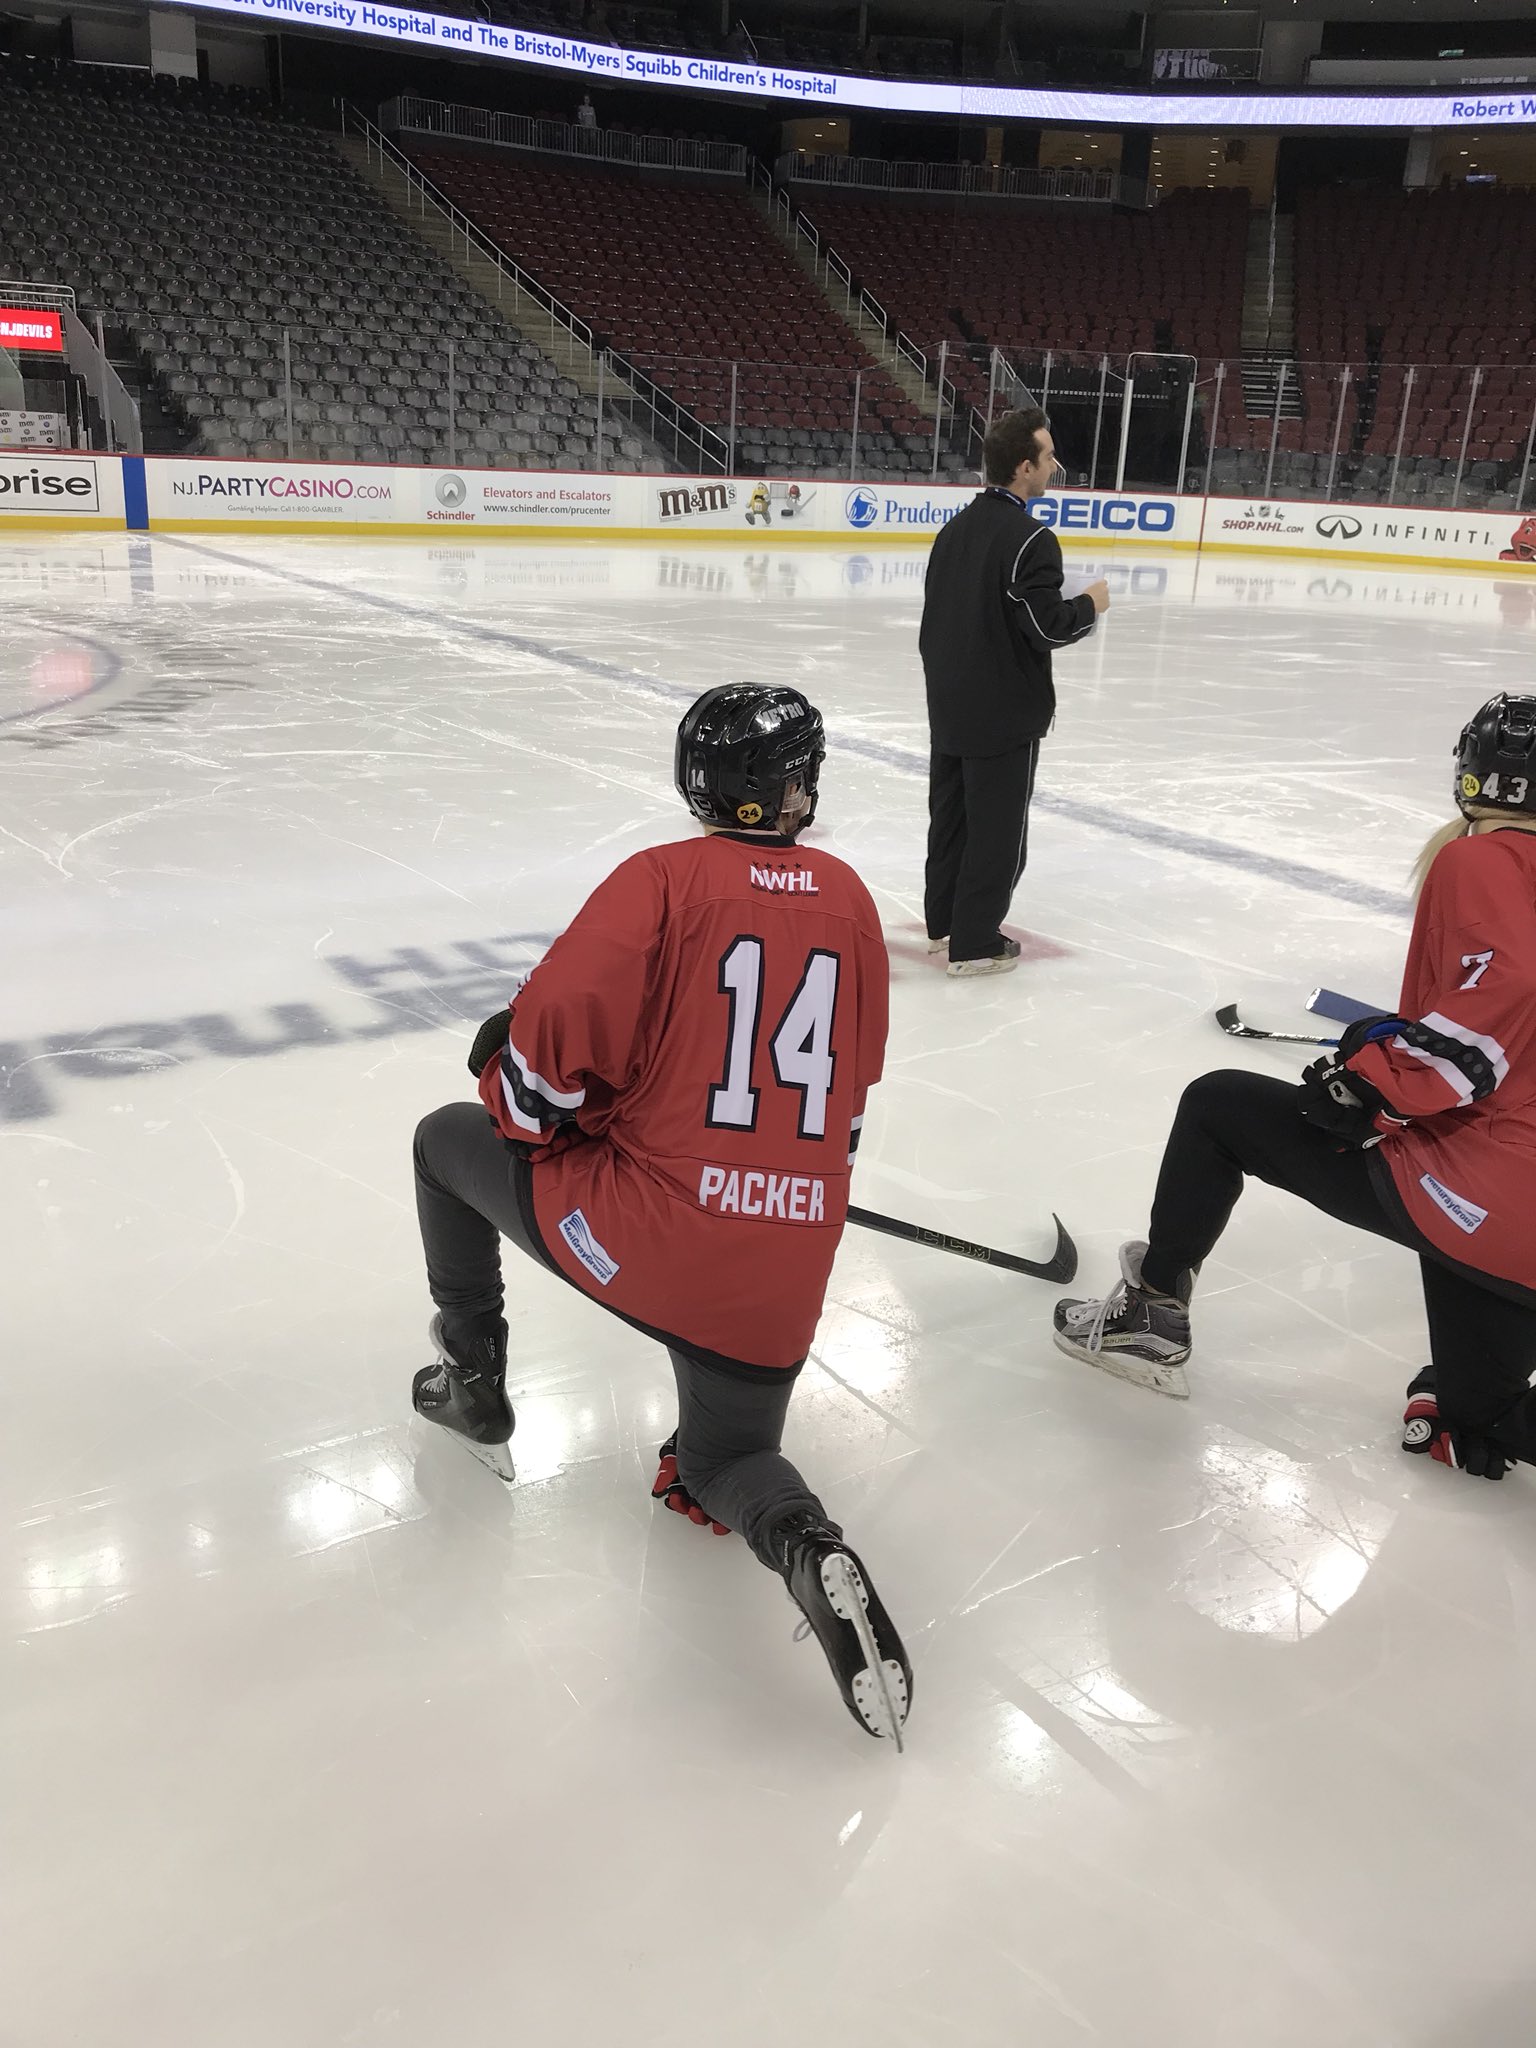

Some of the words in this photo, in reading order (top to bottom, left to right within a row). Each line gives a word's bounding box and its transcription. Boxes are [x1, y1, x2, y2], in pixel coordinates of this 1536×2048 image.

[363, 5, 436, 35] Hospital
[442, 22, 472, 42] and
[478, 28, 509, 48] The
[515, 34, 620, 69] Bristol-Myers
[626, 55, 681, 77] Squibb
[688, 63, 766, 87] Children's
[772, 73, 837, 96] Hospital
[1452, 100, 1515, 118] Robert
[483, 487, 533, 499] Elevators
[536, 488, 556, 500] and
[560, 490, 612, 502] Escalators
[228, 505, 254, 514] Gambling
[280, 505, 291, 513] Call
[426, 510, 476, 521] Schindler
[483, 503, 611, 516] www.schindler.com/prucenter
[1027, 497, 1176, 532] GEICO
[1373, 523, 1490, 546] INFINITI
[785, 752, 811, 769] CCM
[691, 768, 706, 789] 14
[1463, 777, 1477, 792] 24
[1482, 772, 1529, 804] 43
[740, 807, 760, 820] 24
[750, 865, 819, 891] NWHL
[1459, 949, 1494, 991] 7
[705, 934, 840, 1142] 14
[699, 1165, 824, 1222] PACKER
[562, 1222, 608, 1280] MelGrayGroup
